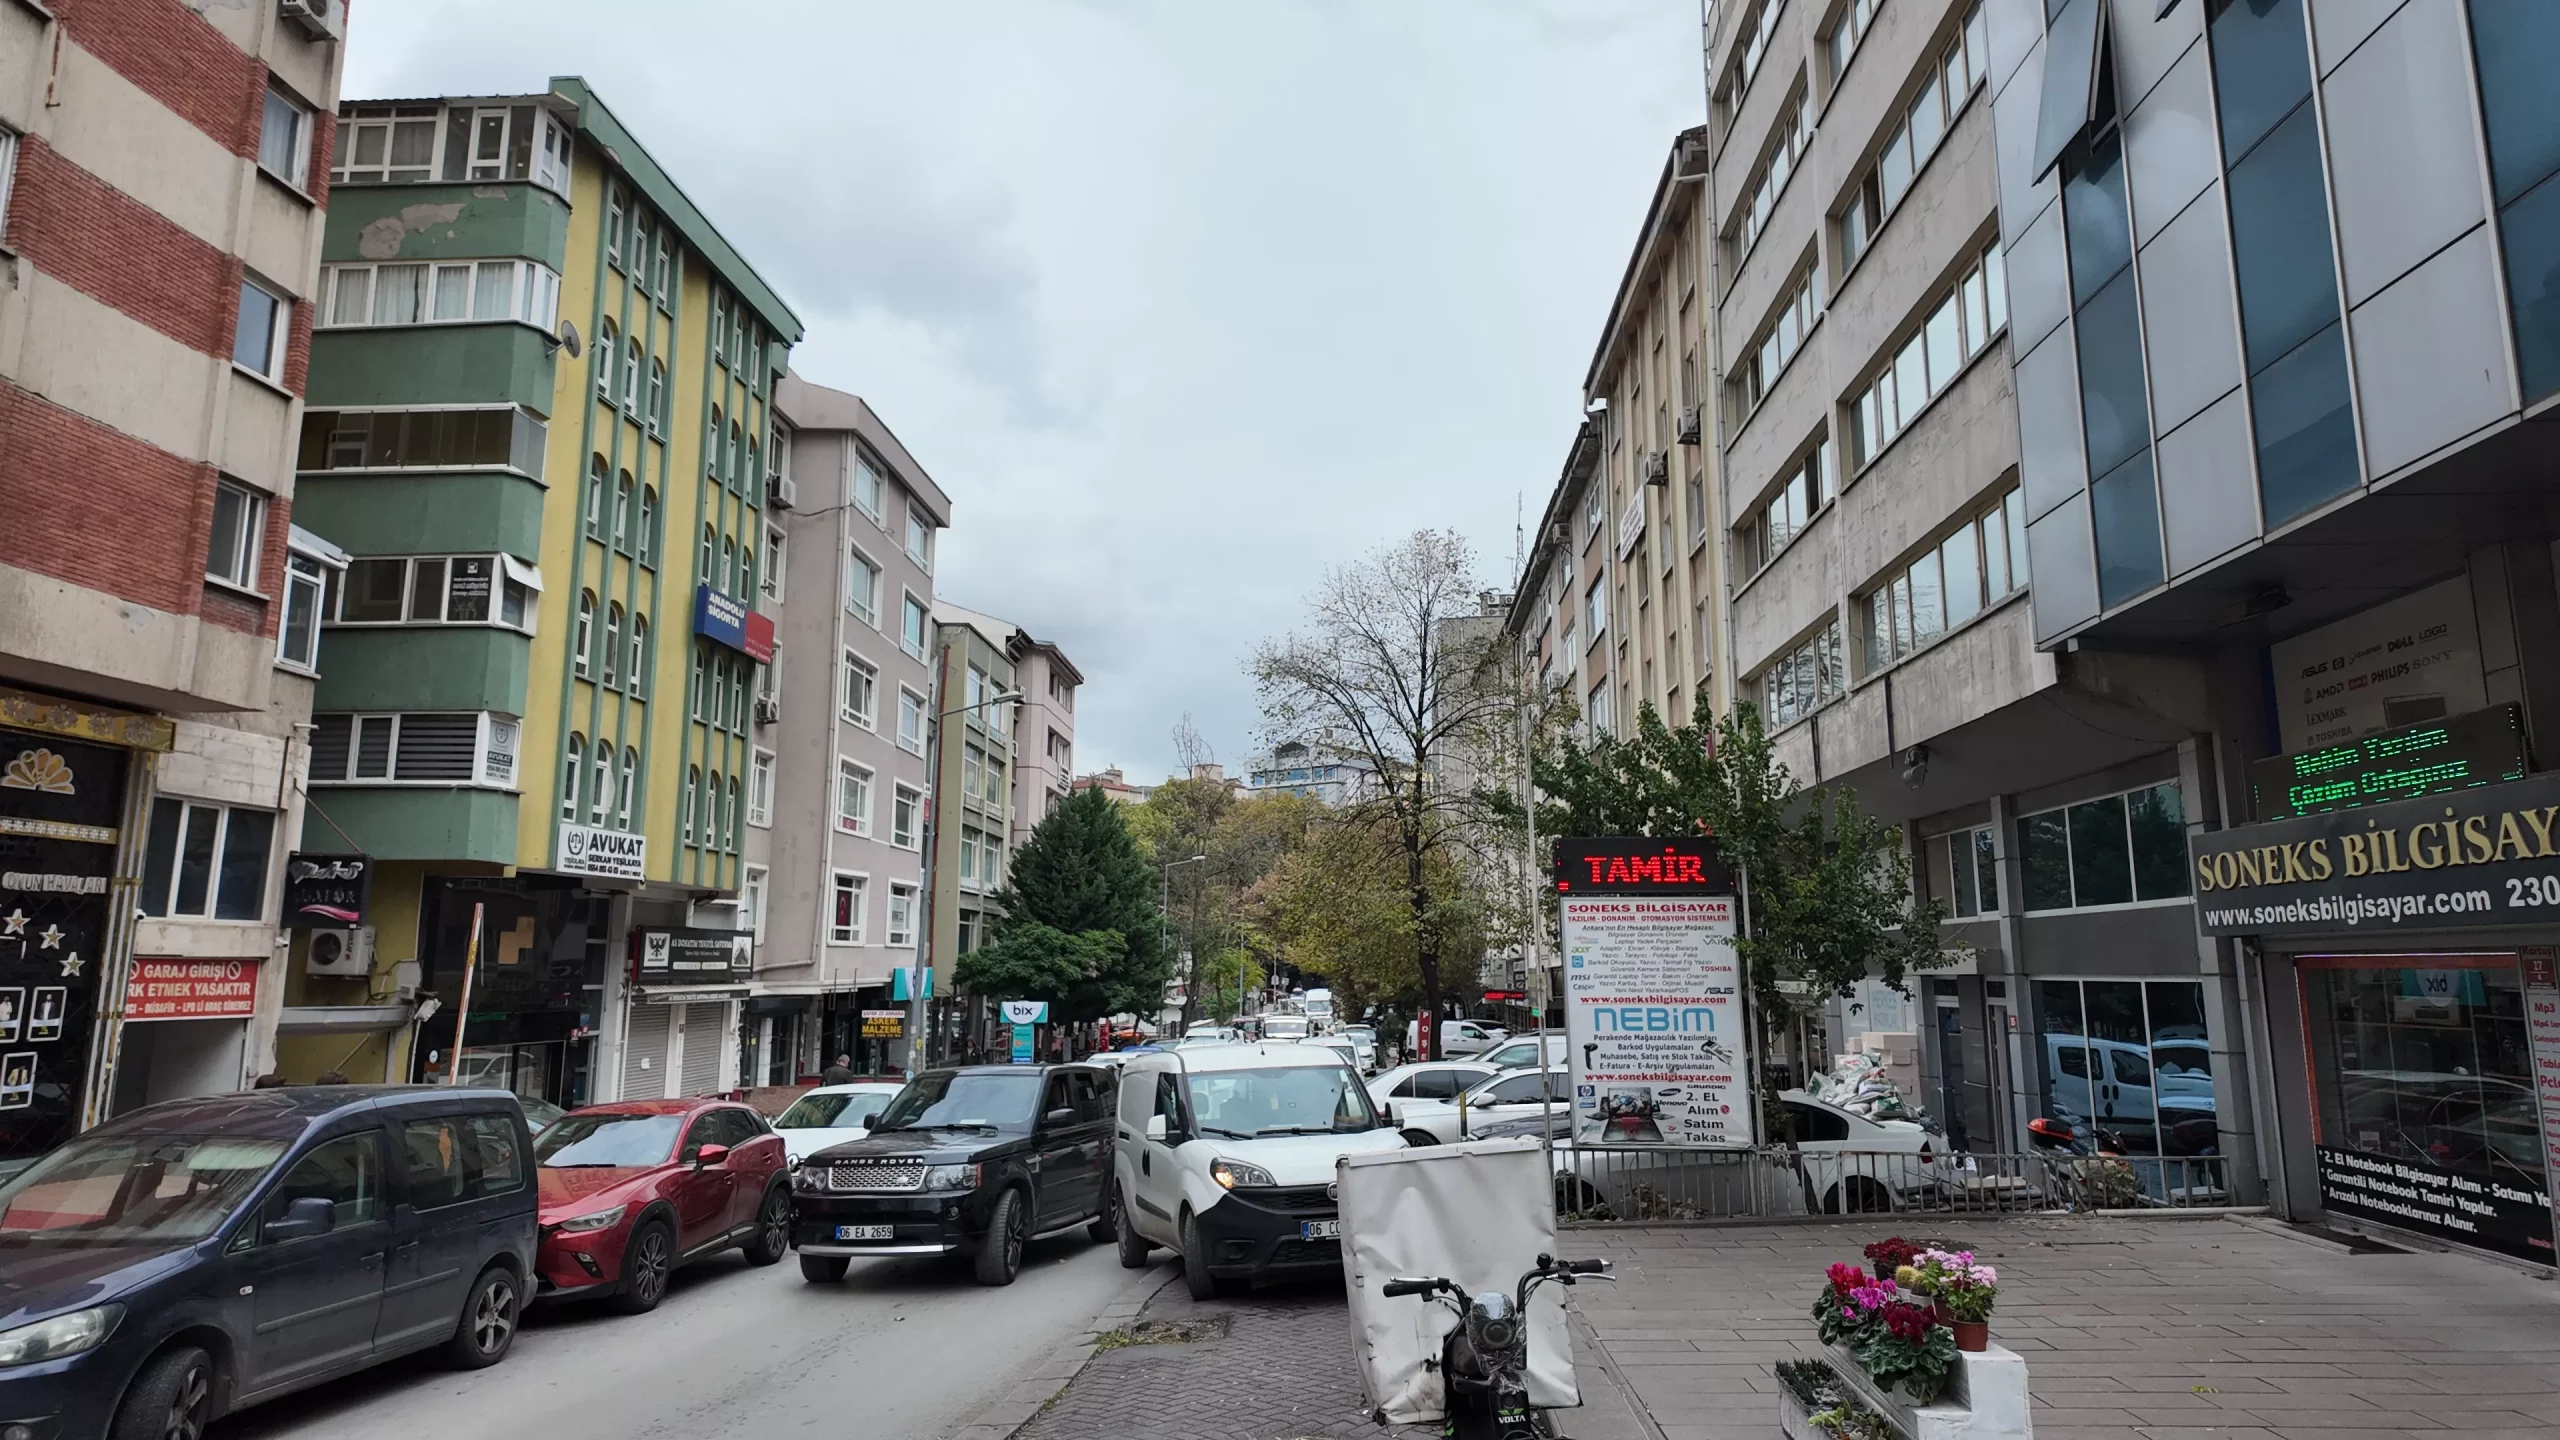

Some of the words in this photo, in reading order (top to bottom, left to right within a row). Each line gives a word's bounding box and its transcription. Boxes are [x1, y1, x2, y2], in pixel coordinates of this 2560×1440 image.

[709, 592, 745, 618] ANADOLU
[708, 604, 739, 628] SİGORTA
[2371, 662, 2410, 684] PHILIPS
[2412, 650, 2452, 670] SONY
[2306, 706, 2347, 726] LEXMARK
[2316, 726, 2352, 743] TOSHIBA
[589, 833, 643, 856] AVUKAT
[1584, 846, 1706, 884] TAMİR
[2198, 838, 2334, 892] SONEKS
[1568, 904, 1630, 912] SONEKS
[1636, 902, 1727, 912] BİLGİSAYAR
[2206, 888, 2491, 927] www.soneksbilgisayar.com
[144, 964, 186, 978] GARAJ
[189, 962, 225, 981] GİRİŞİ
[148, 983, 191, 996] ETMEK
[194, 982, 251, 996] YASAKTIR
[1580, 995, 1727, 1005] www.soneksbilgisayar.com
[1013, 1005, 1032, 1015] bix
[2534, 1003, 2555, 1014] Mp3
[862, 1025, 902, 1034] MALZEME
[1634, 1034, 1676, 1042] Mağazacılık
[1646, 1044, 1694, 1052] Uygulamaları
[1666, 1063, 1715, 1071] Uygulamaları
[1585, 1073, 1732, 1082] www.soneksbilgisayar.com
[1686, 1092, 1698, 1101] 2.
[1704, 1092, 1719, 1102] EL
[1688, 1105, 1718, 1115] Alım
[1684, 1119, 1724, 1129] Satım
[1684, 1132, 1726, 1143] Takas
[2324, 1150, 2334, 1163] 2.
[2335, 1152, 2345, 1166] El
[2346, 1154, 2394, 1176] Notebook
[2395, 1164, 2448, 1188] Bilgisayar
[2452, 1175, 2482, 1193] Alımı
[2492, 1183, 2533, 1204] Satımı
[2327, 1168, 2367, 1188] Garantili
[2368, 1177, 2418, 1199] Notebook
[2420, 1188, 2455, 1208] Tamiri
[2456, 1196, 2497, 1217] Yapılır.
[2329, 1186, 2358, 1204] Arızalı
[2360, 1193, 2441, 1224] Notebooklarınız
[2444, 1213, 2478, 1233] Alınır.
[840, 1226, 850, 1238] 06
[856, 1227, 866, 1238] EA
[871, 1226, 892, 1237] 2659
[1310, 1223, 1322, 1235] 06
[1498, 1415, 1526, 1424] VOLTA
